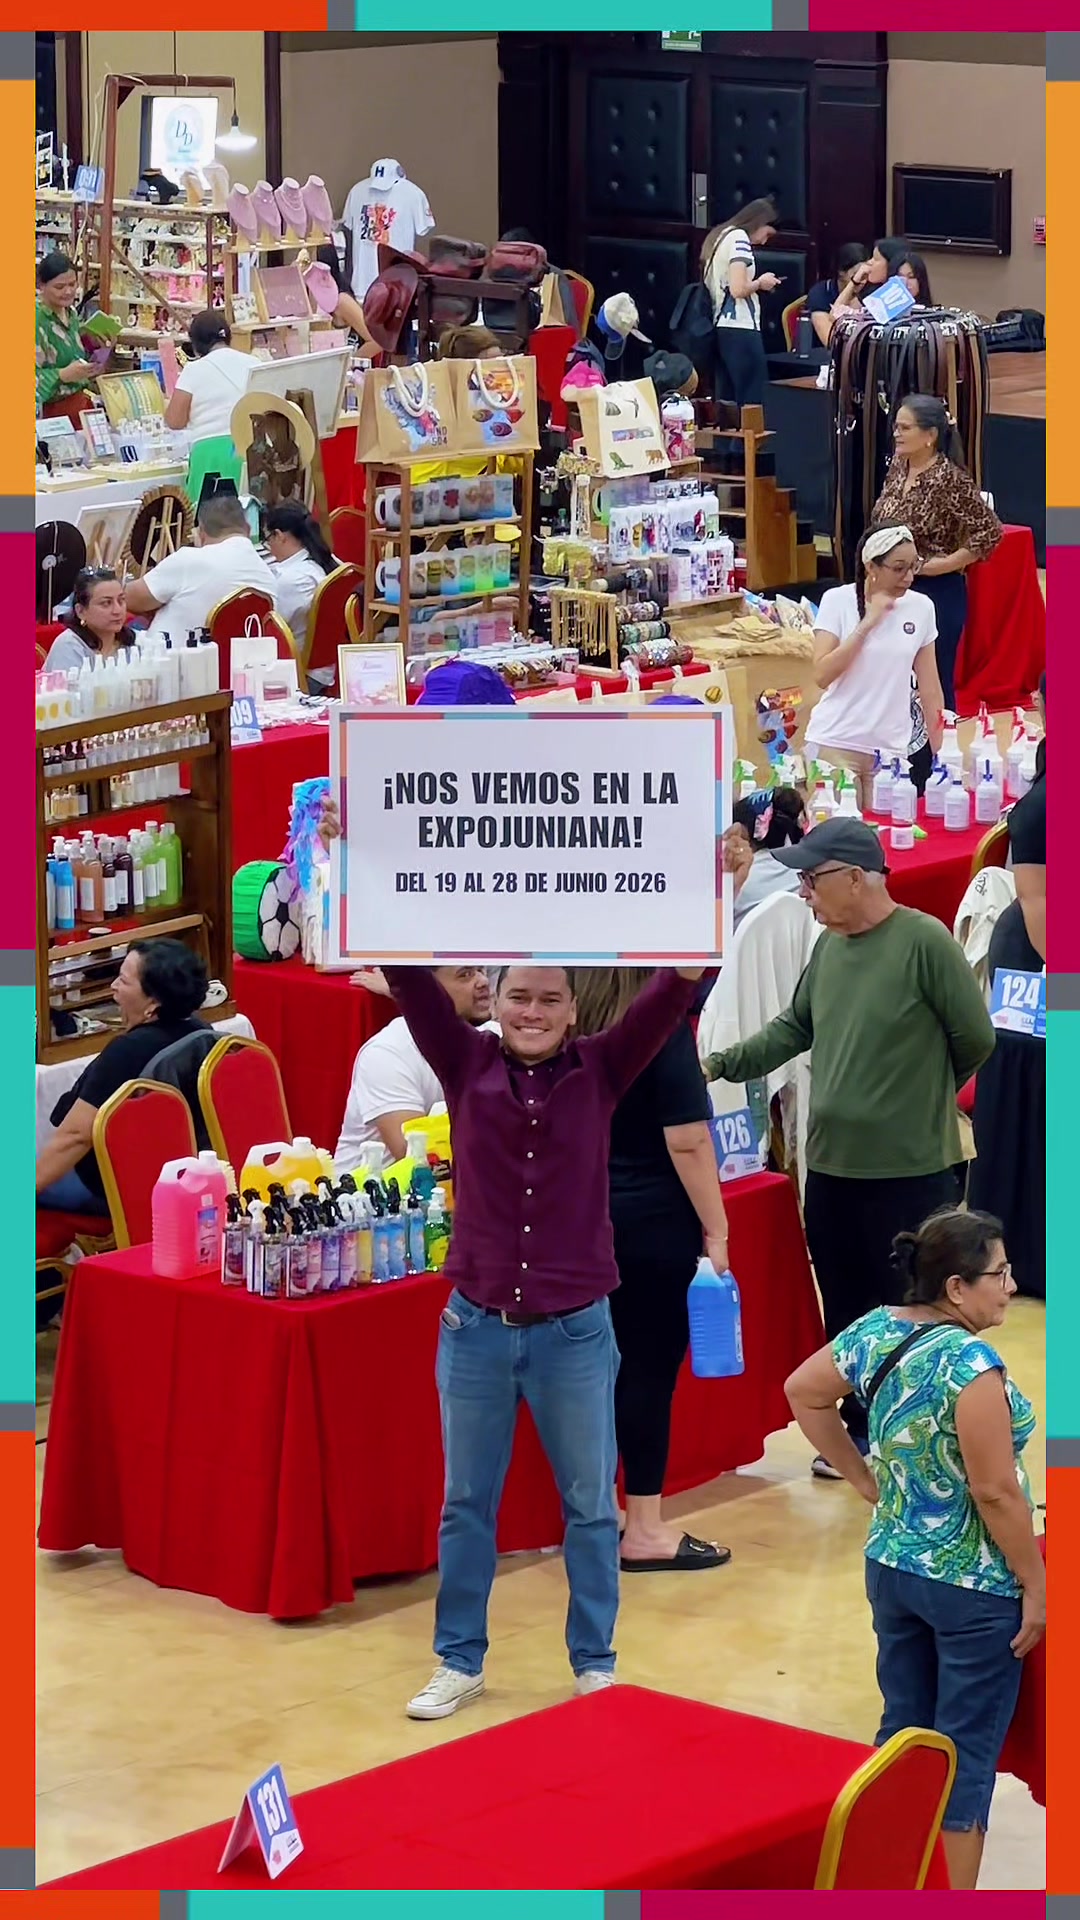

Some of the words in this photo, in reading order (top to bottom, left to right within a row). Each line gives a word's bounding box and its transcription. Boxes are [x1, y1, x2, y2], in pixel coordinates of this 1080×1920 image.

[375, 166, 385, 177] H
[880, 283, 909, 310] 107
[232, 699, 253, 727] 09
[384, 772, 458, 809] ¡NOS
[471, 772, 580, 804] VEMOS
[593, 772, 630, 804] EN
[643, 772, 679, 804] LA
[418, 816, 643, 848] EXPOJUNIANA!
[395, 872, 427, 892] DEL
[434, 872, 456, 892] 19
[463, 872, 485, 892] AL
[492, 872, 518, 892] 28
[525, 872, 548, 892] DE
[554, 872, 607, 892] JUNIO
[614, 872, 667, 893] 2026
[1001, 974, 1041, 1010] 124
[715, 1114, 751, 1154] 126
[256, 1775, 287, 1836] 131
